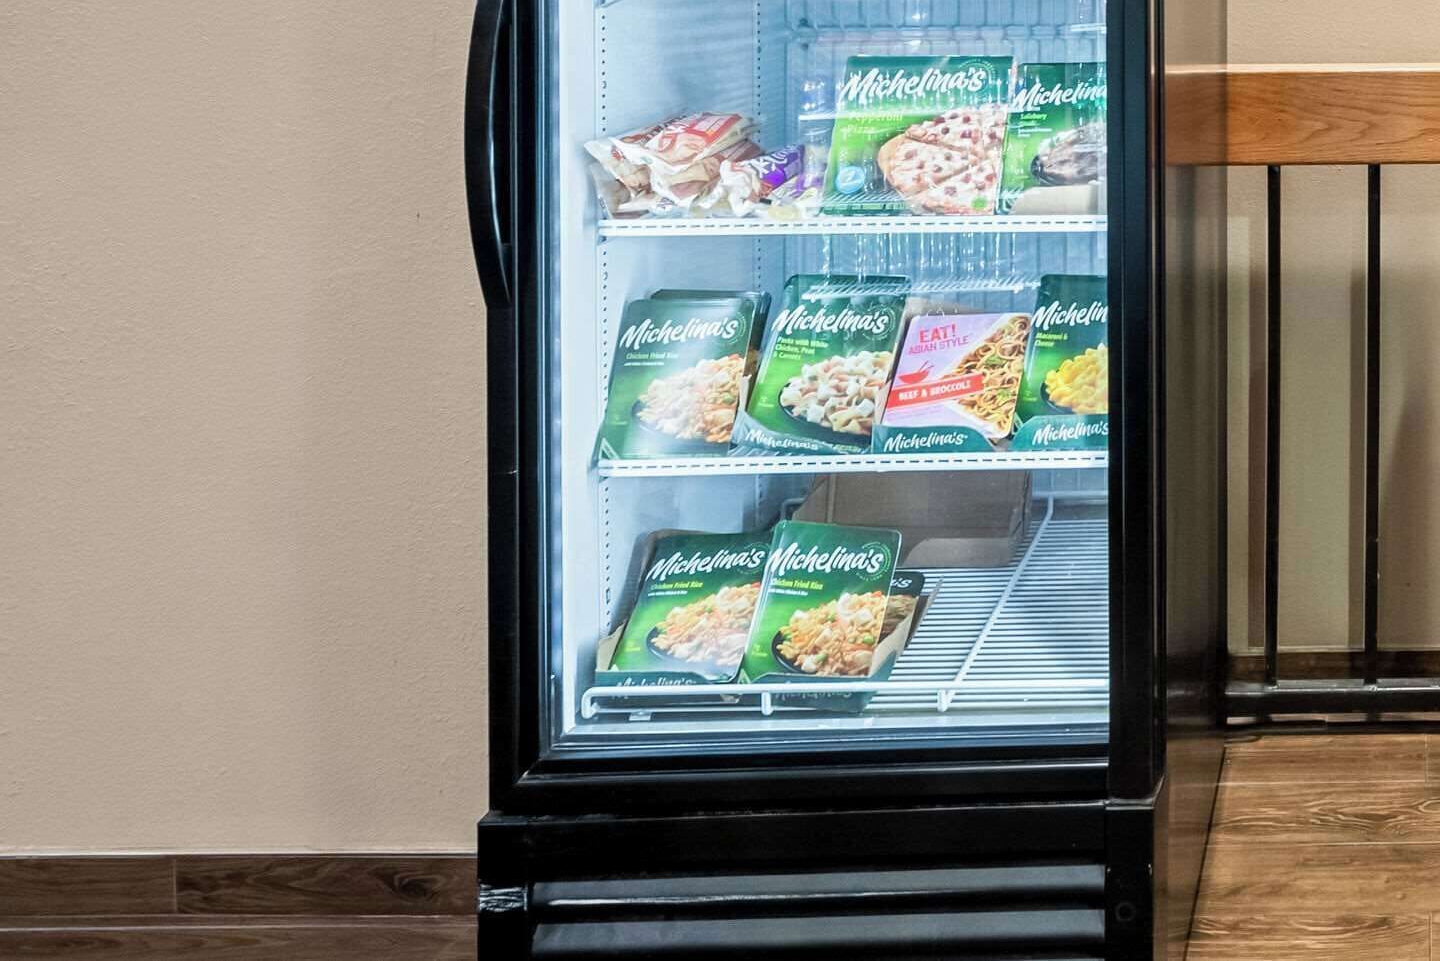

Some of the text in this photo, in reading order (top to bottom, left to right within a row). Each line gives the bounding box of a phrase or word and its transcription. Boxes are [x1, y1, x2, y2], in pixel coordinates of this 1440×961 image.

[839, 67, 986, 101] Michelina's
[849, 110, 903, 123] Pepperoni
[772, 304, 889, 335] Michelina's
[619, 317, 739, 351] Michelina's
[918, 323, 957, 344] EAT!
[908, 335, 969, 356] ASIAN STYLE
[898, 389, 919, 401] BEEF
[930, 380, 972, 397] BROCCOLI
[746, 429, 820, 451] Michelina's
[884, 432, 966, 452] Michelina's
[1032, 420, 1109, 446] Michelina's
[644, 548, 766, 582] Michelina's
[764, 542, 885, 576] Michelina's
[771, 577, 793, 587] Chicken
